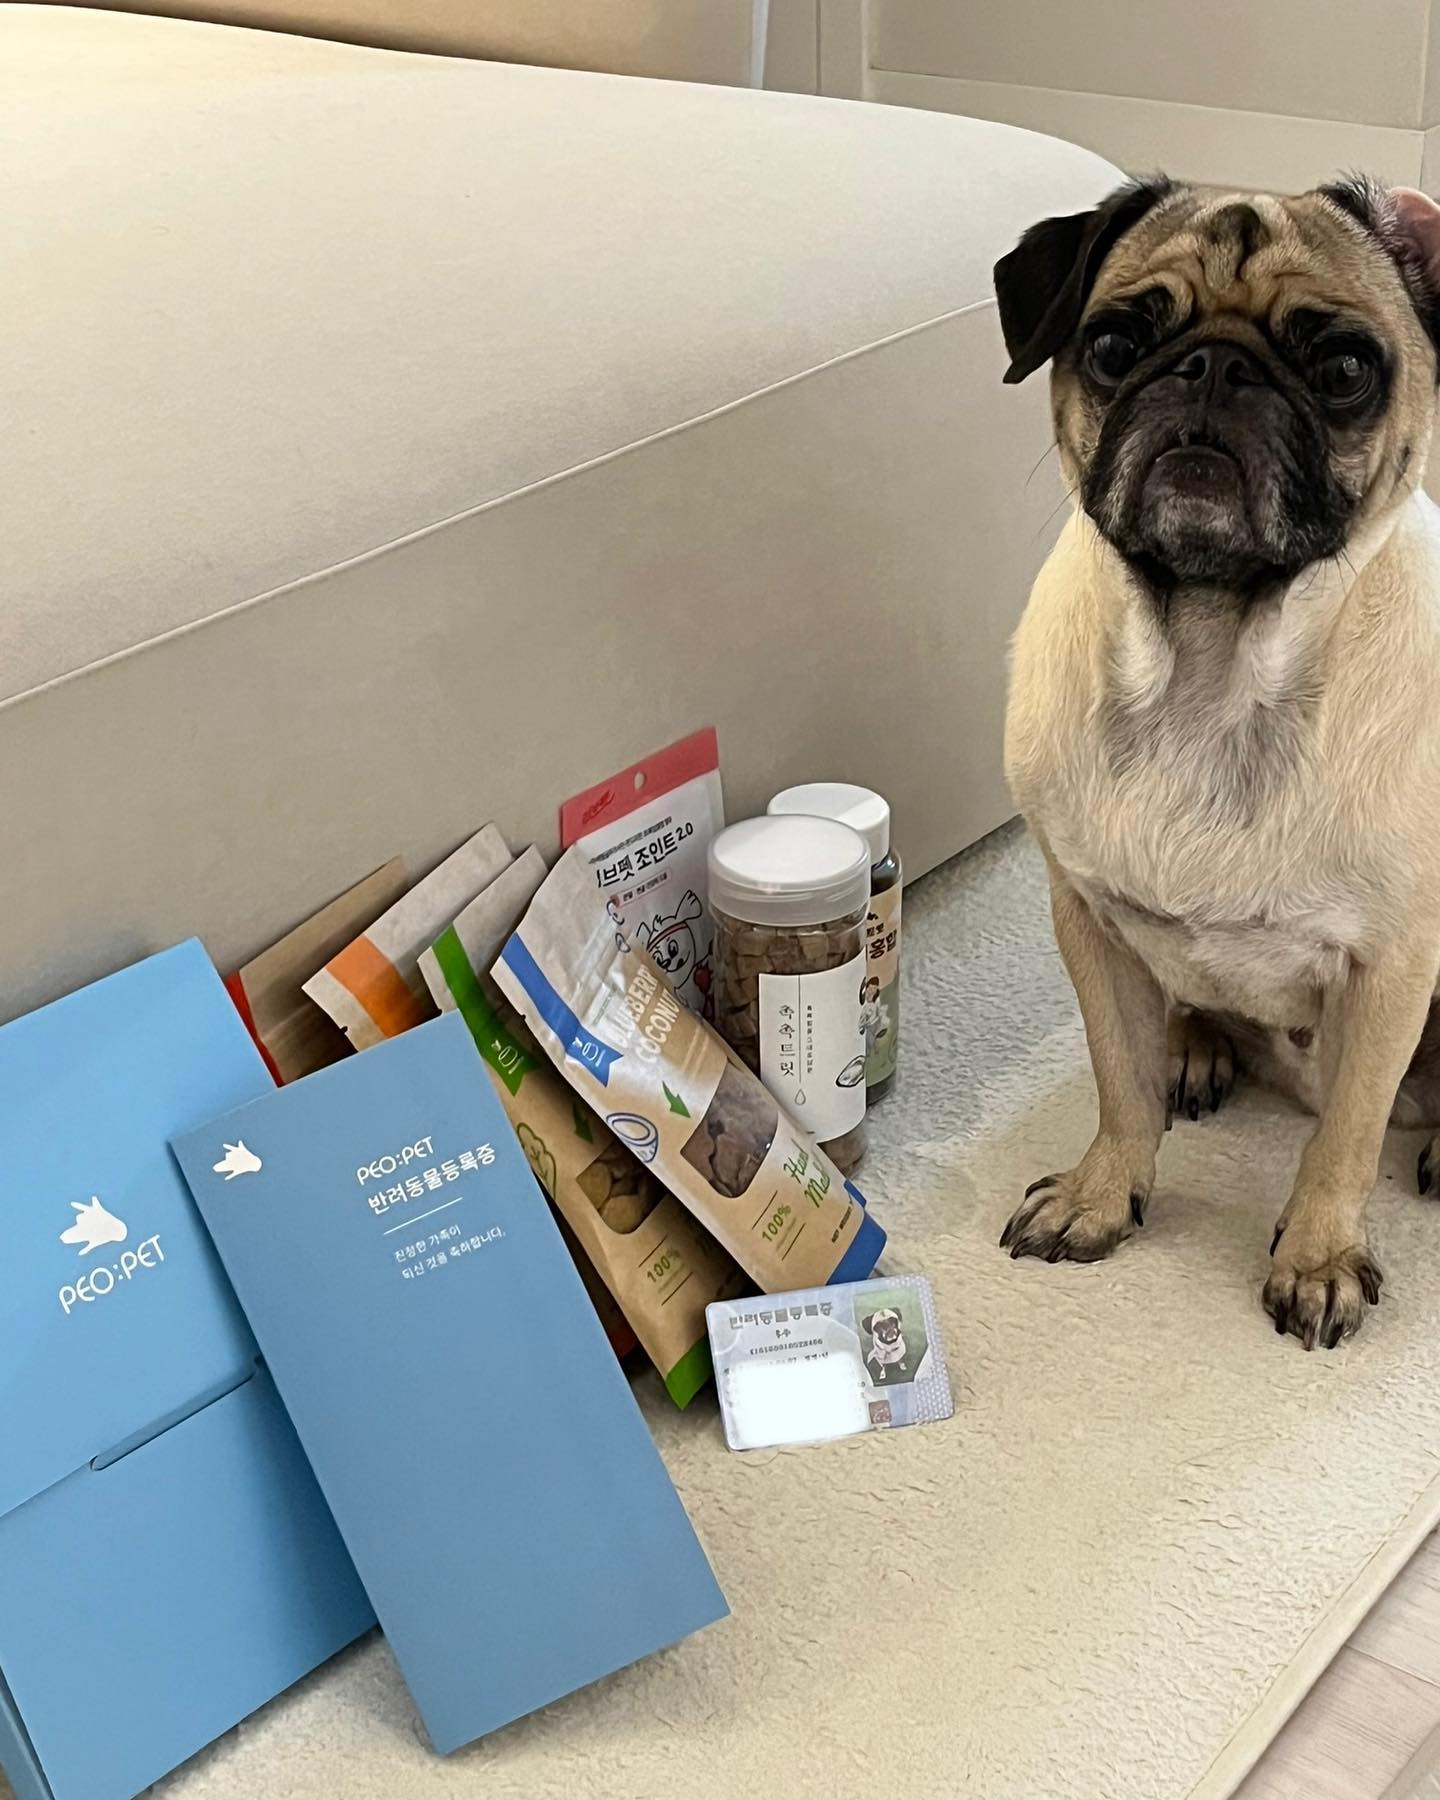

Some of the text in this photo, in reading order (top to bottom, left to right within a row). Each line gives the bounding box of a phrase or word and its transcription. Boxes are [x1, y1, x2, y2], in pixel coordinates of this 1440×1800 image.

[634, 832, 678, 870] 조인트
[675, 822, 694, 841] 2.0
[605, 964, 659, 1048] BLUEBERR
[368, 1143, 496, 1215] 반려동물등록증
[428, 1224, 462, 1246] 가족이
[762, 1203, 792, 1242] 100%
